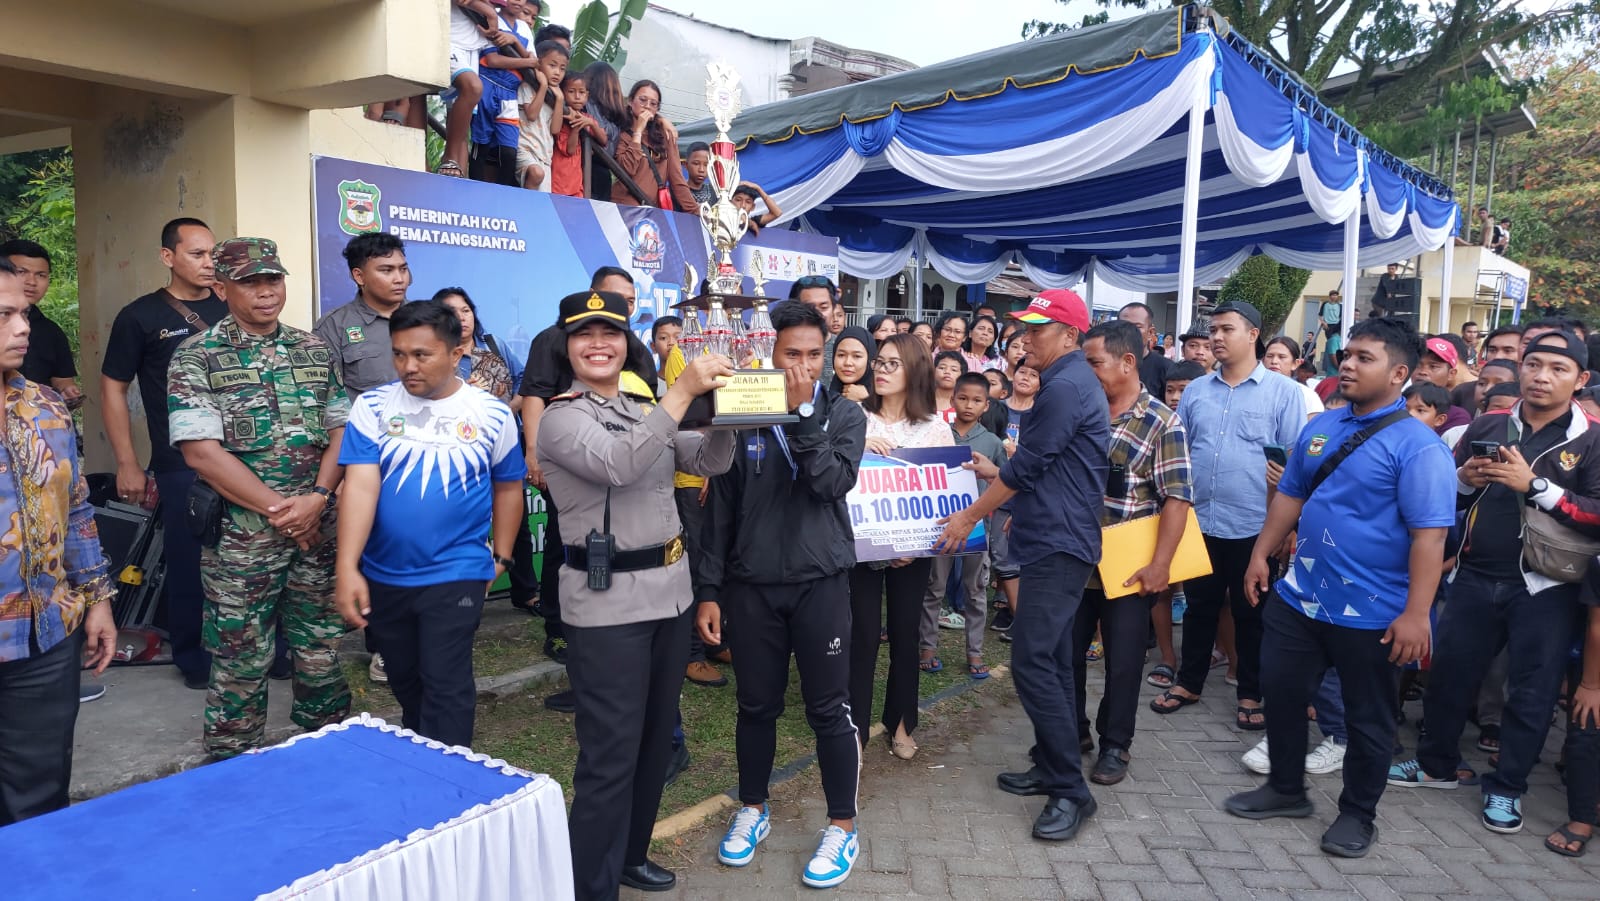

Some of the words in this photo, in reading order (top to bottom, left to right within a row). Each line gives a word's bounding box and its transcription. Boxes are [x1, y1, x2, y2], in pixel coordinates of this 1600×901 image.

[389, 205, 480, 230] PEMERINTAH
[481, 217, 518, 233] KOTA
[390, 226, 527, 252] PEMATANGSIANTAR
[304, 370, 319, 378] TNI
[320, 370, 328, 378] AD
[732, 376, 759, 385] JUARA
[761, 376, 769, 384] III
[859, 467, 922, 494] JUARA
[924, 466, 948, 490] III
[850, 503, 869, 526] p.
[870, 493, 973, 522] 10.000.000
